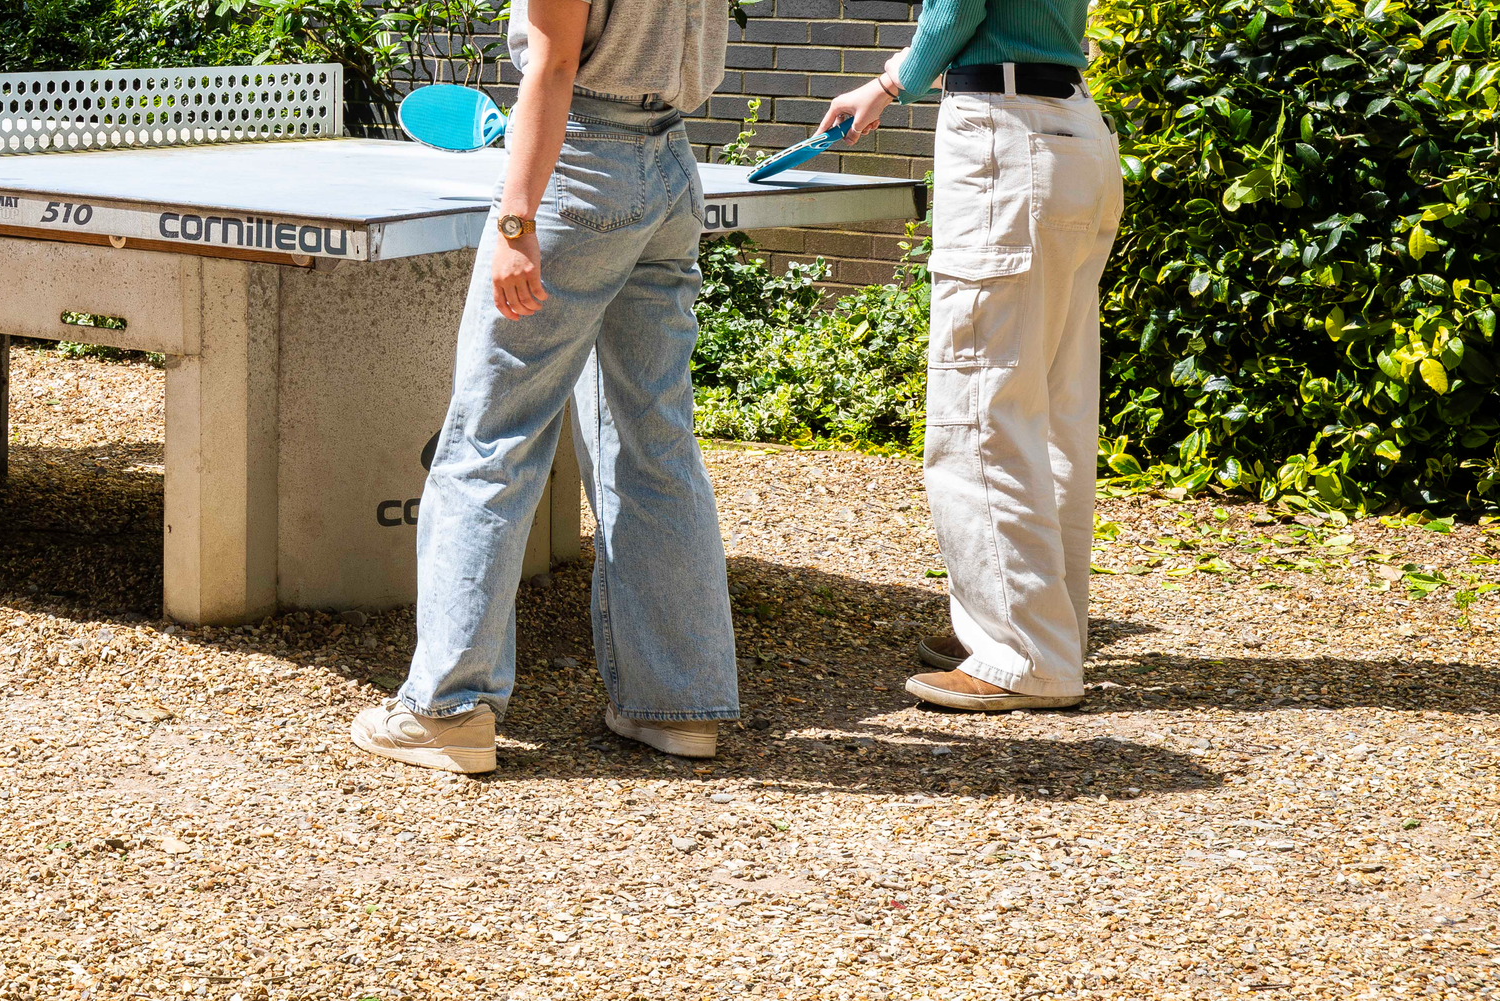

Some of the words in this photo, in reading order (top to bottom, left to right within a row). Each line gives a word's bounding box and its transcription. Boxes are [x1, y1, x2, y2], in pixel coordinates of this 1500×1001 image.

[40, 202, 93, 225] 510
[159, 212, 347, 255] cornilleau
[703, 204, 738, 229] au
[376, 498, 421, 526] co
